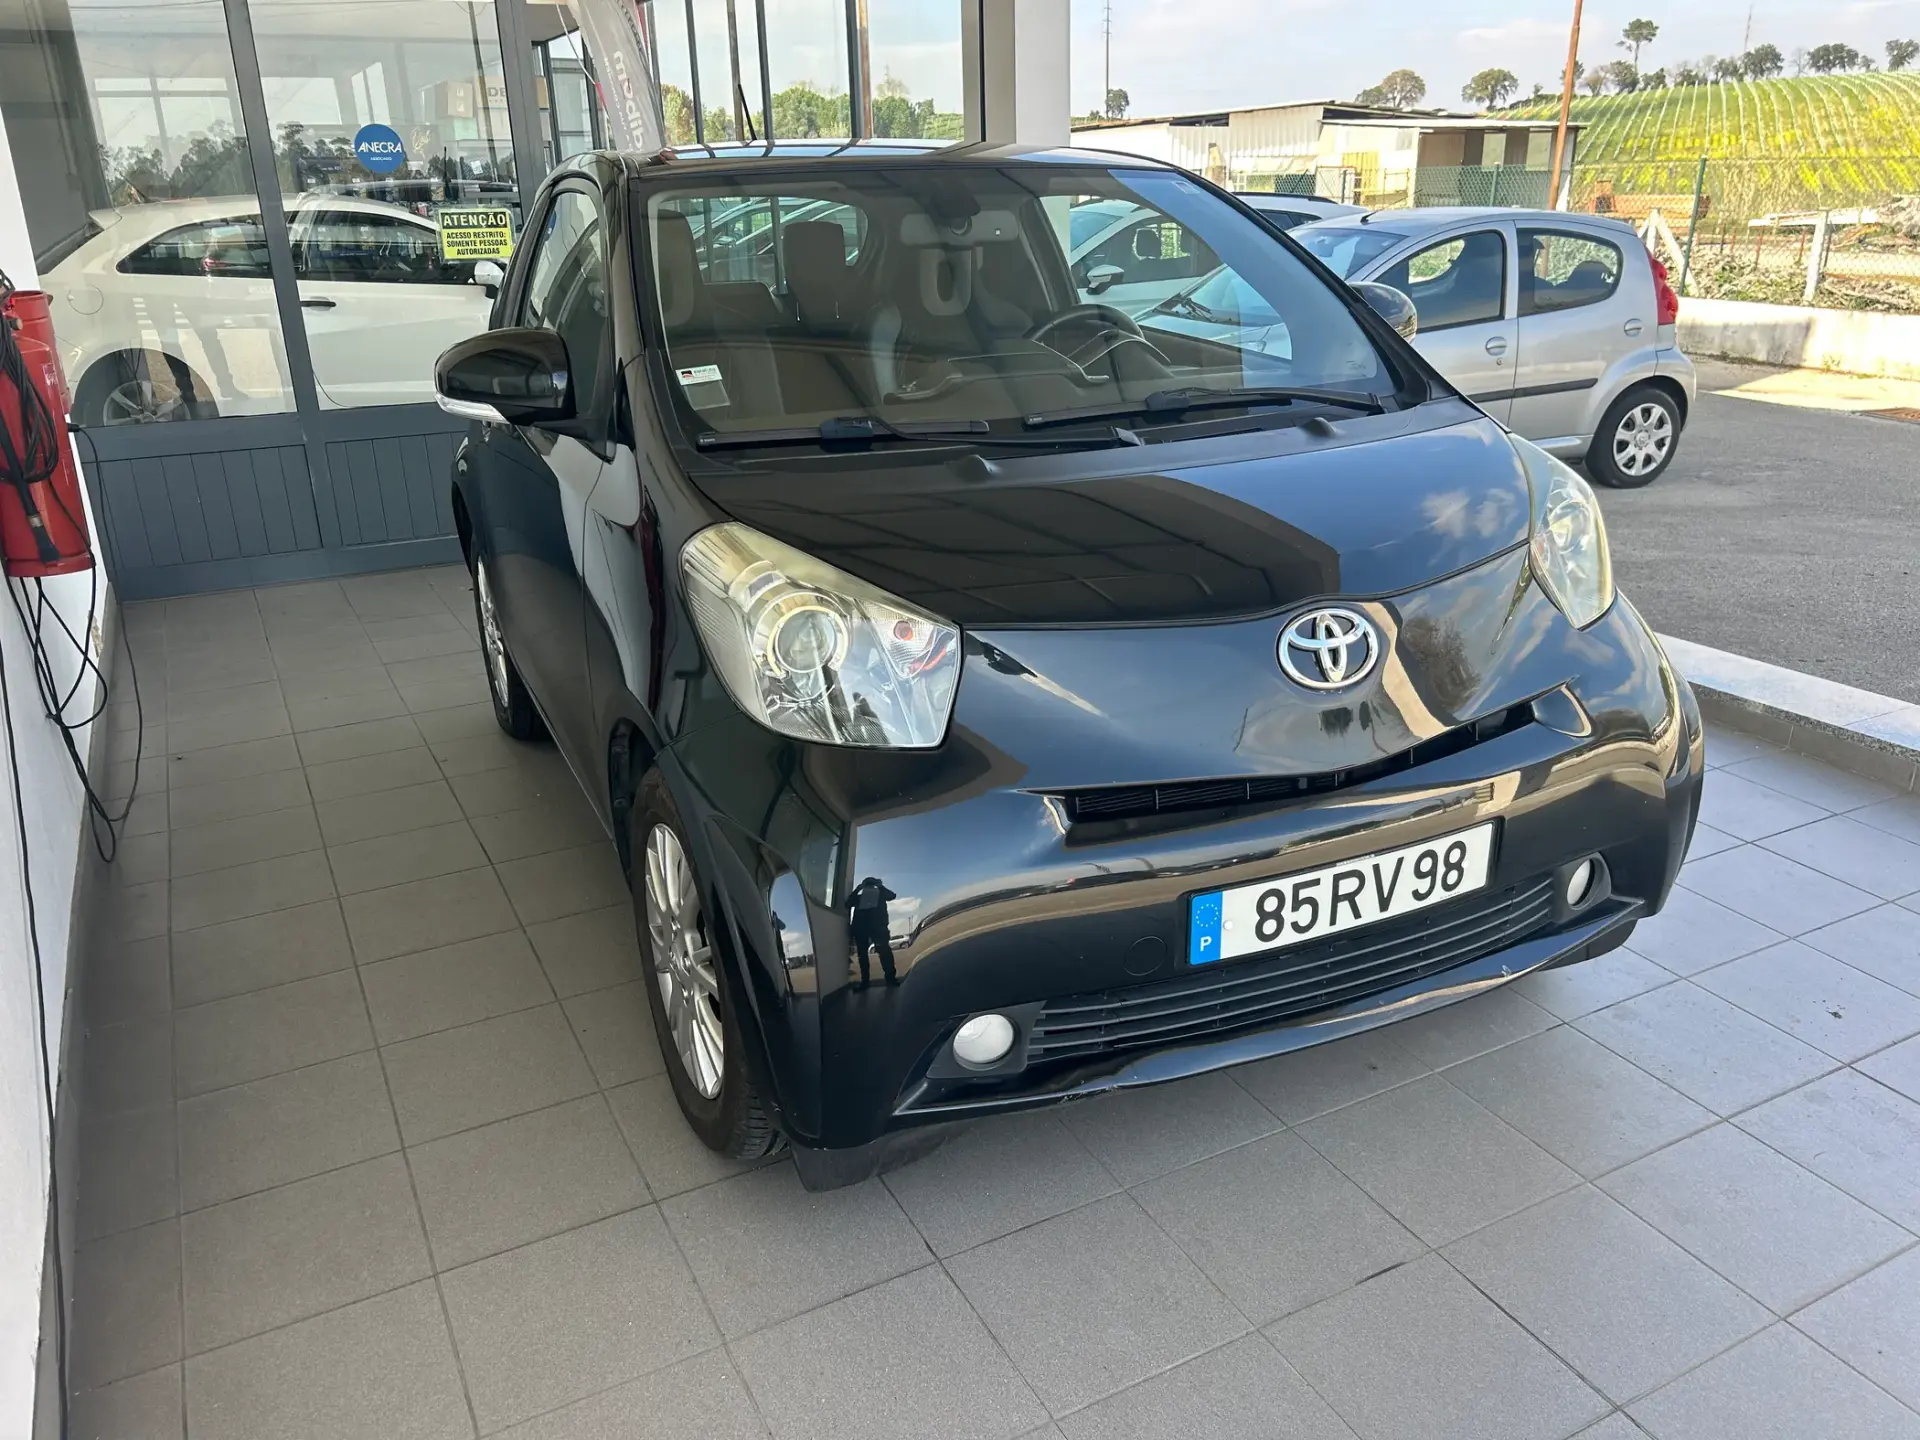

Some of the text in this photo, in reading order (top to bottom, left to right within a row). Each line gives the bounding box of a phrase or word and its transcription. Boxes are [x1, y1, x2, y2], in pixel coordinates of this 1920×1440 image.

[358, 141, 402, 153] ANECRA
[443, 212, 506, 227] ATENÇÃO
[446, 230, 506, 239] ACESSO RESTRITO:
[479, 239, 508, 247] PESSOAS
[456, 247, 500, 255] AUTORIZADAS
[1199, 935, 1212, 952] P
